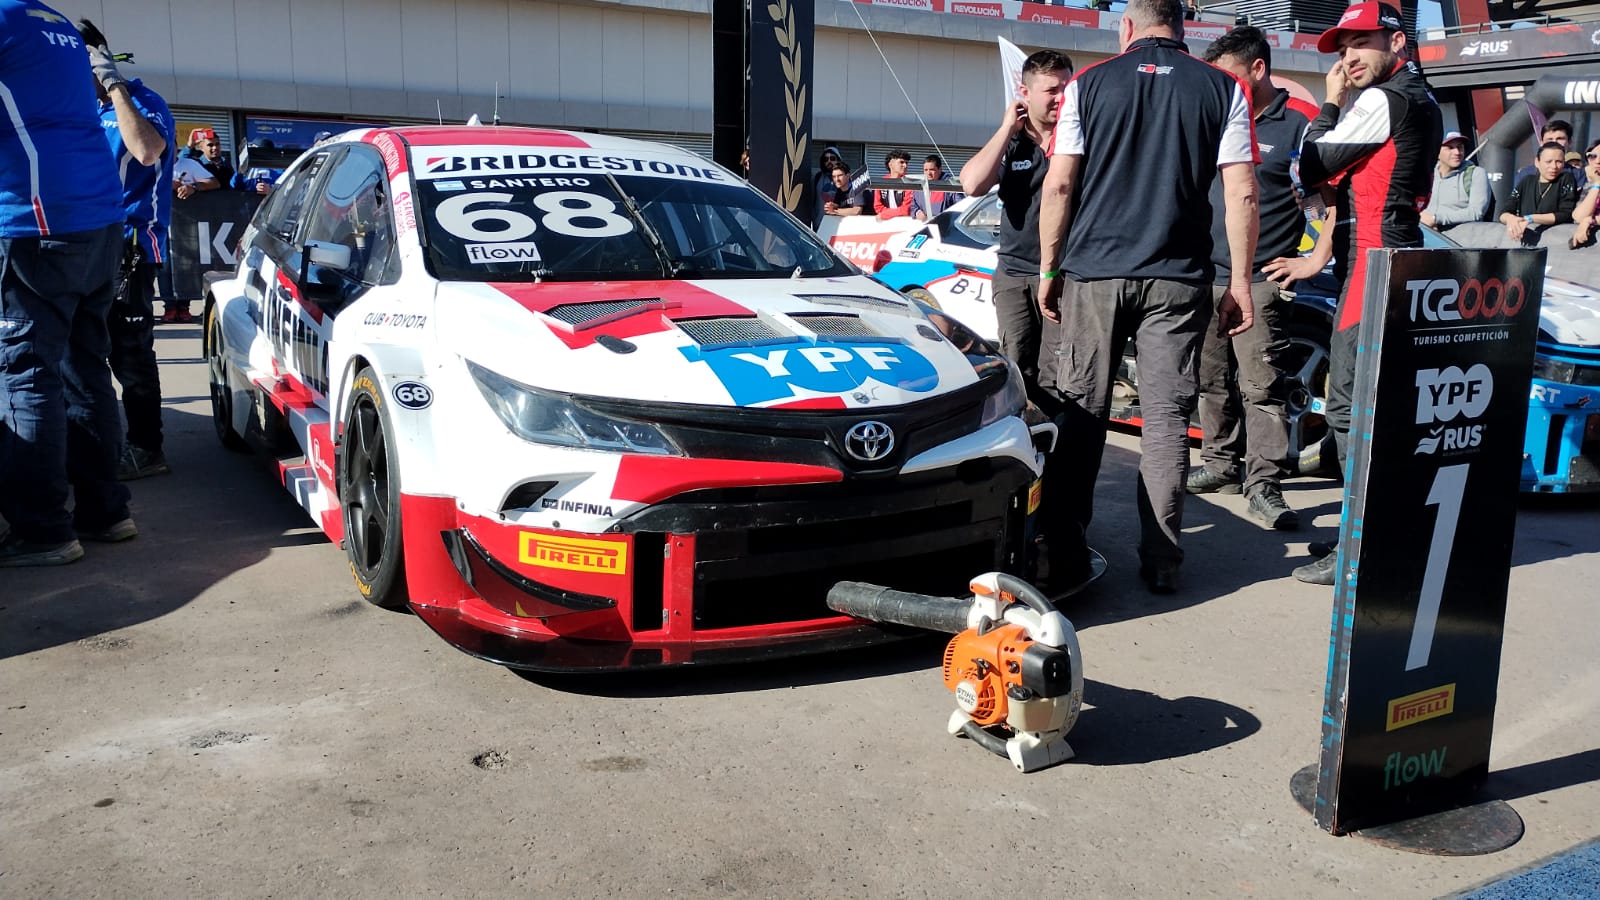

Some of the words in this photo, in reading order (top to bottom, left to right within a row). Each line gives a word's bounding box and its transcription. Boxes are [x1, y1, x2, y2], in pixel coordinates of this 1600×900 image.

[953, 5, 1000, 17] REVOLUCIÓN
[41, 30, 79, 49] YPF
[1480, 40, 1510, 54] RUS
[1564, 80, 1600, 104] IN
[427, 154, 727, 182] BRIDGESTONE
[470, 177, 590, 190] SANTERO
[435, 191, 634, 242] 68
[198, 221, 238, 265] K
[469, 246, 536, 261] flow
[1405, 277, 1525, 323] TC2000
[363, 312, 387, 326] CLUB
[389, 313, 428, 330] TOYOTA
[1413, 333, 1451, 346] TURISMO
[1453, 329, 1510, 343] COMPETICIÓN
[730, 346, 903, 378] YPF
[397, 386, 430, 403] 68
[1415, 362, 1494, 425] 100
[1427, 379, 1483, 408] YPF
[1443, 424, 1483, 451] RUS
[560, 500, 614, 518] INFINIA
[527, 537, 619, 569] PIRELLI
[1405, 462, 1470, 672] 1
[957, 687, 976, 702] STIHL
[1391, 690, 1450, 724] PIRELLI
[1384, 744, 1448, 792] flow
